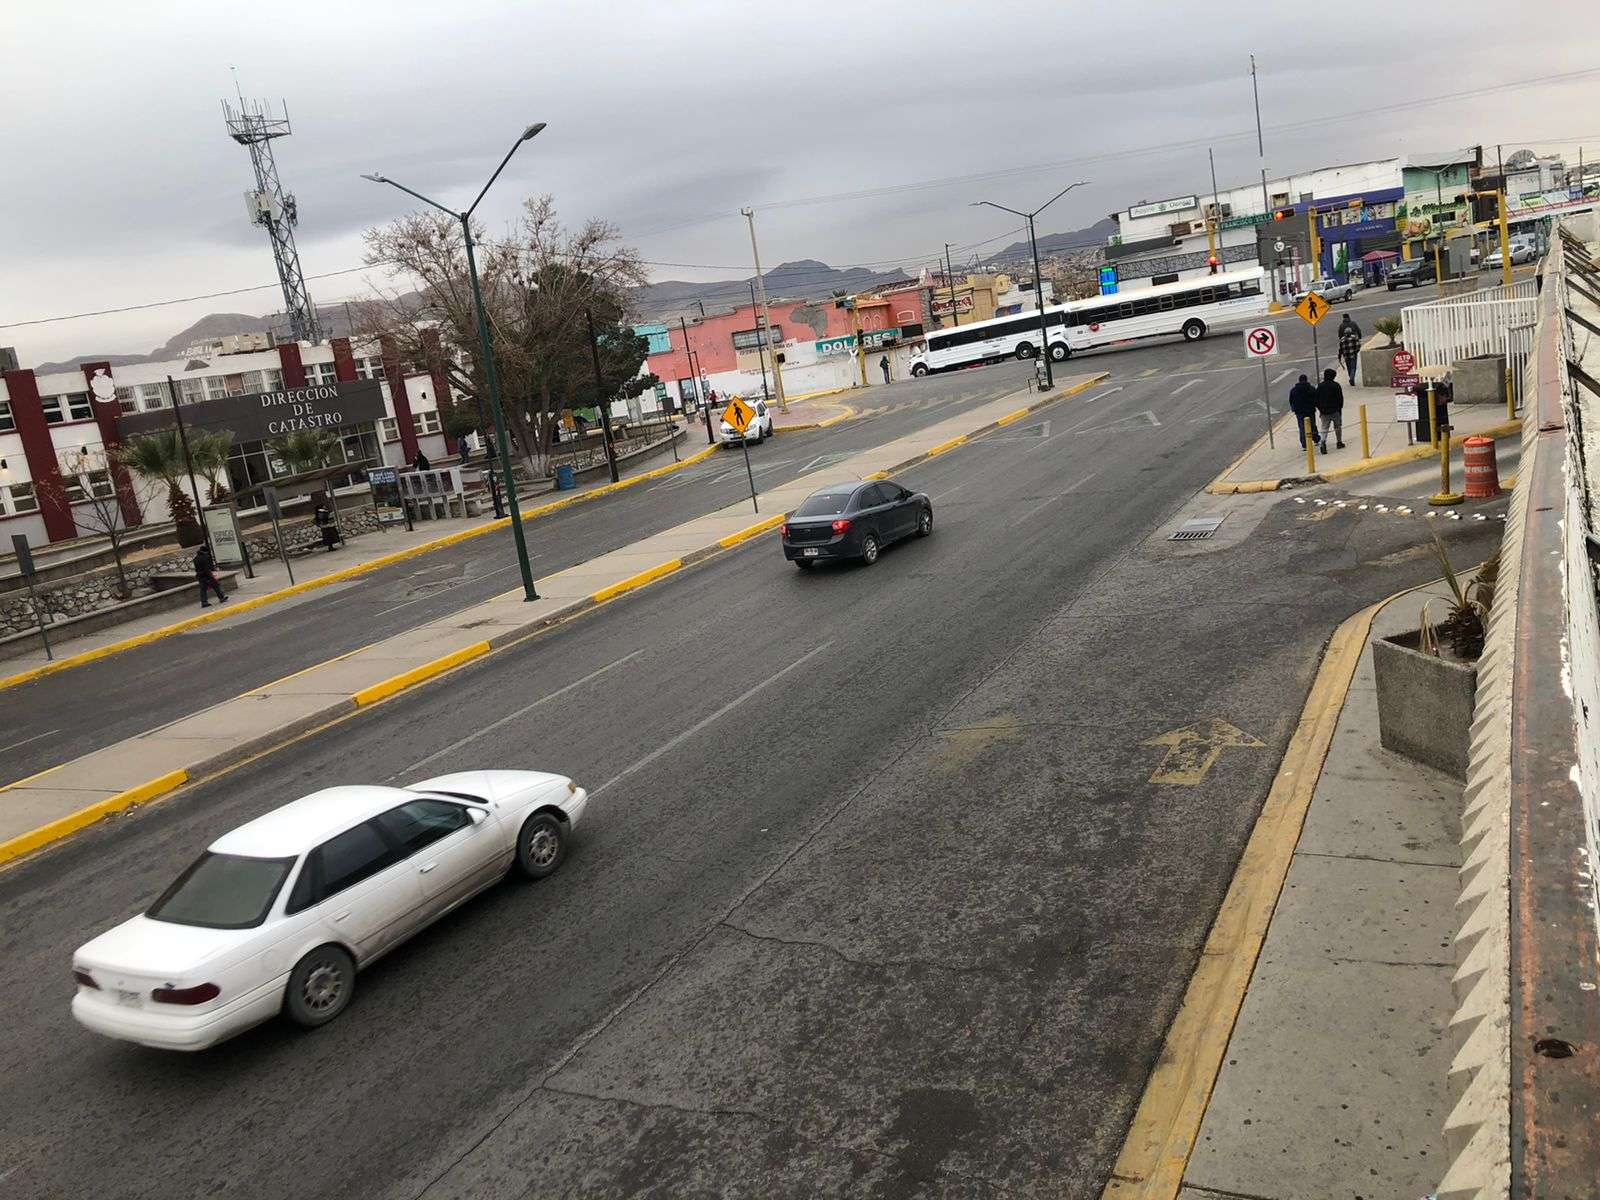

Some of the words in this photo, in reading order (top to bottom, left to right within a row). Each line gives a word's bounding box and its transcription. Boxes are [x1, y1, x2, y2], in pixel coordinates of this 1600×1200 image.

[260, 386, 339, 407] DIRECCION
[293, 402, 314, 416] DE
[268, 412, 342, 434] CATASTRO
